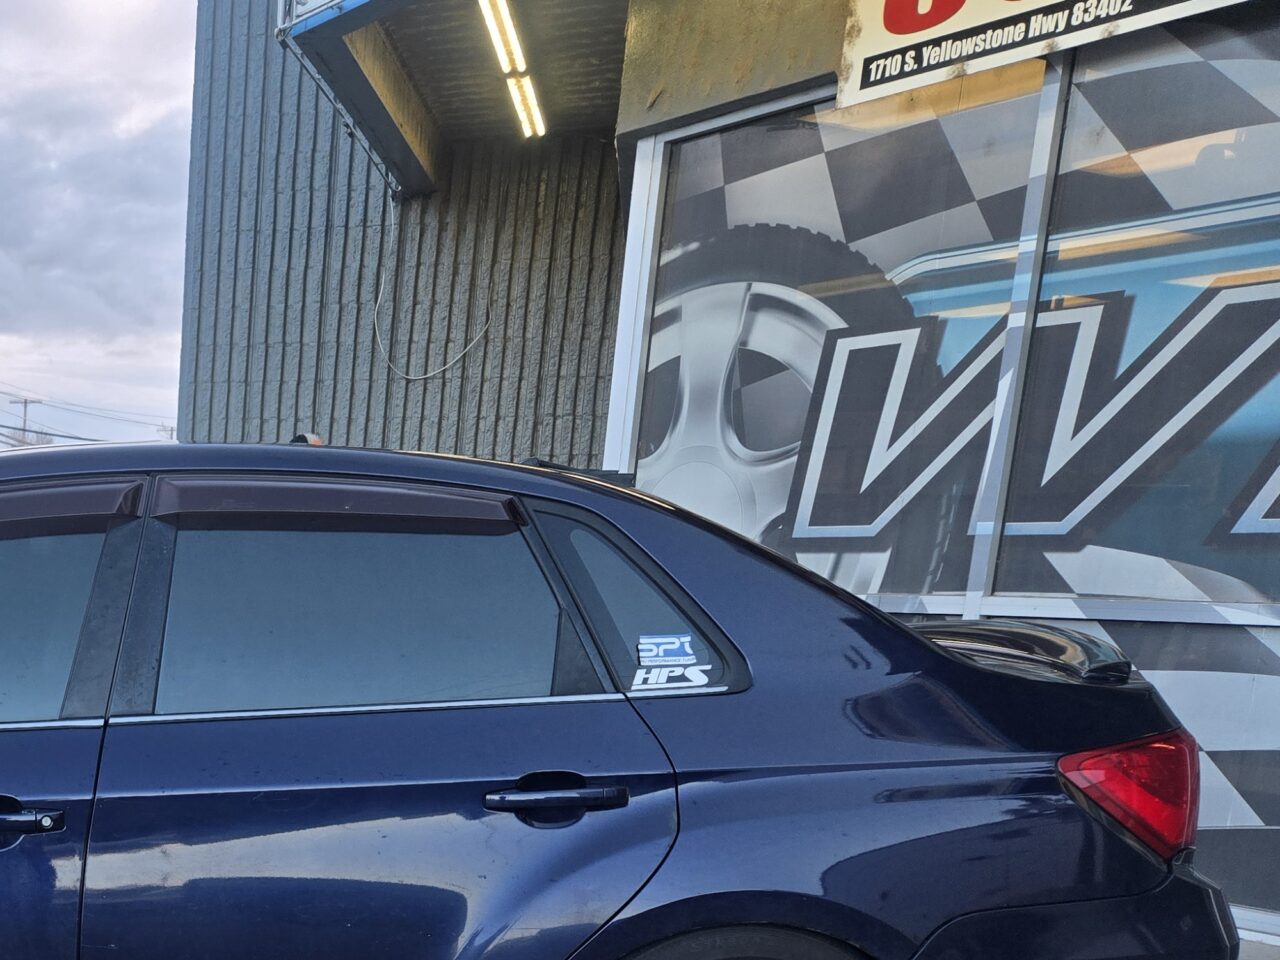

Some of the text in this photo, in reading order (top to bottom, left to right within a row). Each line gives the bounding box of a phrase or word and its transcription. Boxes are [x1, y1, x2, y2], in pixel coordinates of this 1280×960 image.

[869, 54, 902, 82] 1710
[904, 50, 918, 72] S.
[922, 22, 1026, 67] Yellowstone
[1028, 9, 1070, 38] Hwy
[631, 664, 712, 690] HPS
